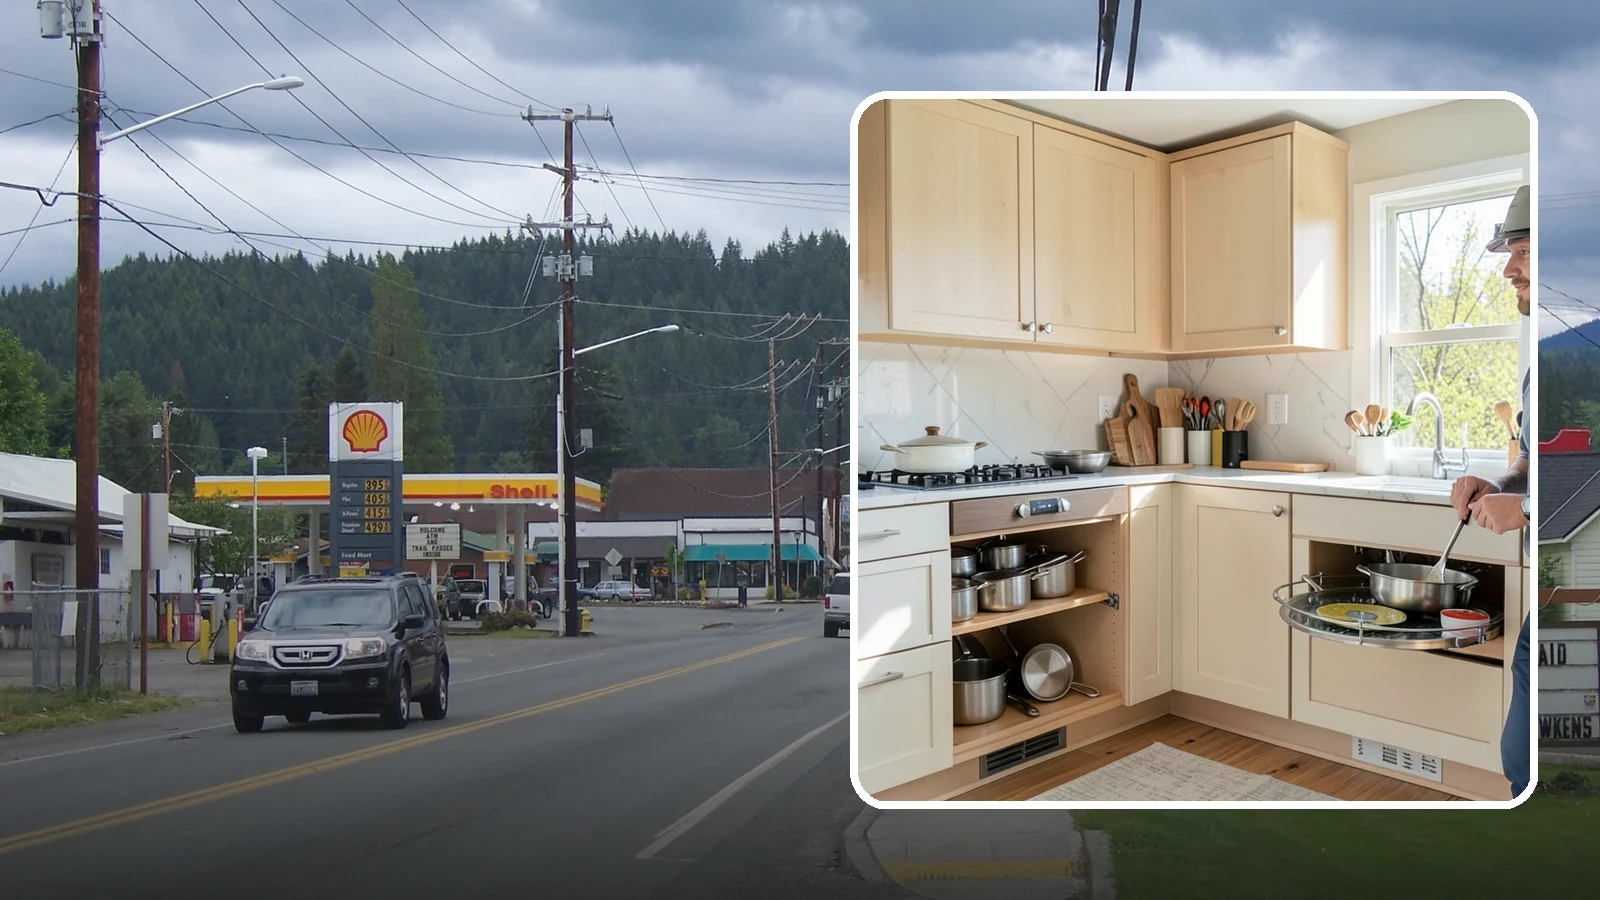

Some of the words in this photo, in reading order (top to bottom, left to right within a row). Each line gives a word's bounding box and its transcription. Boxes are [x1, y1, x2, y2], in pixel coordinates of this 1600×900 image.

[366, 480, 383, 490] 395
[490, 484, 547, 499] Shell
[366, 494, 383, 504] 405
[366, 508, 383, 518] 415
[366, 522, 383, 532] 429
[1539, 643, 1567, 665] AID
[1539, 716, 1592, 739] WKENS
